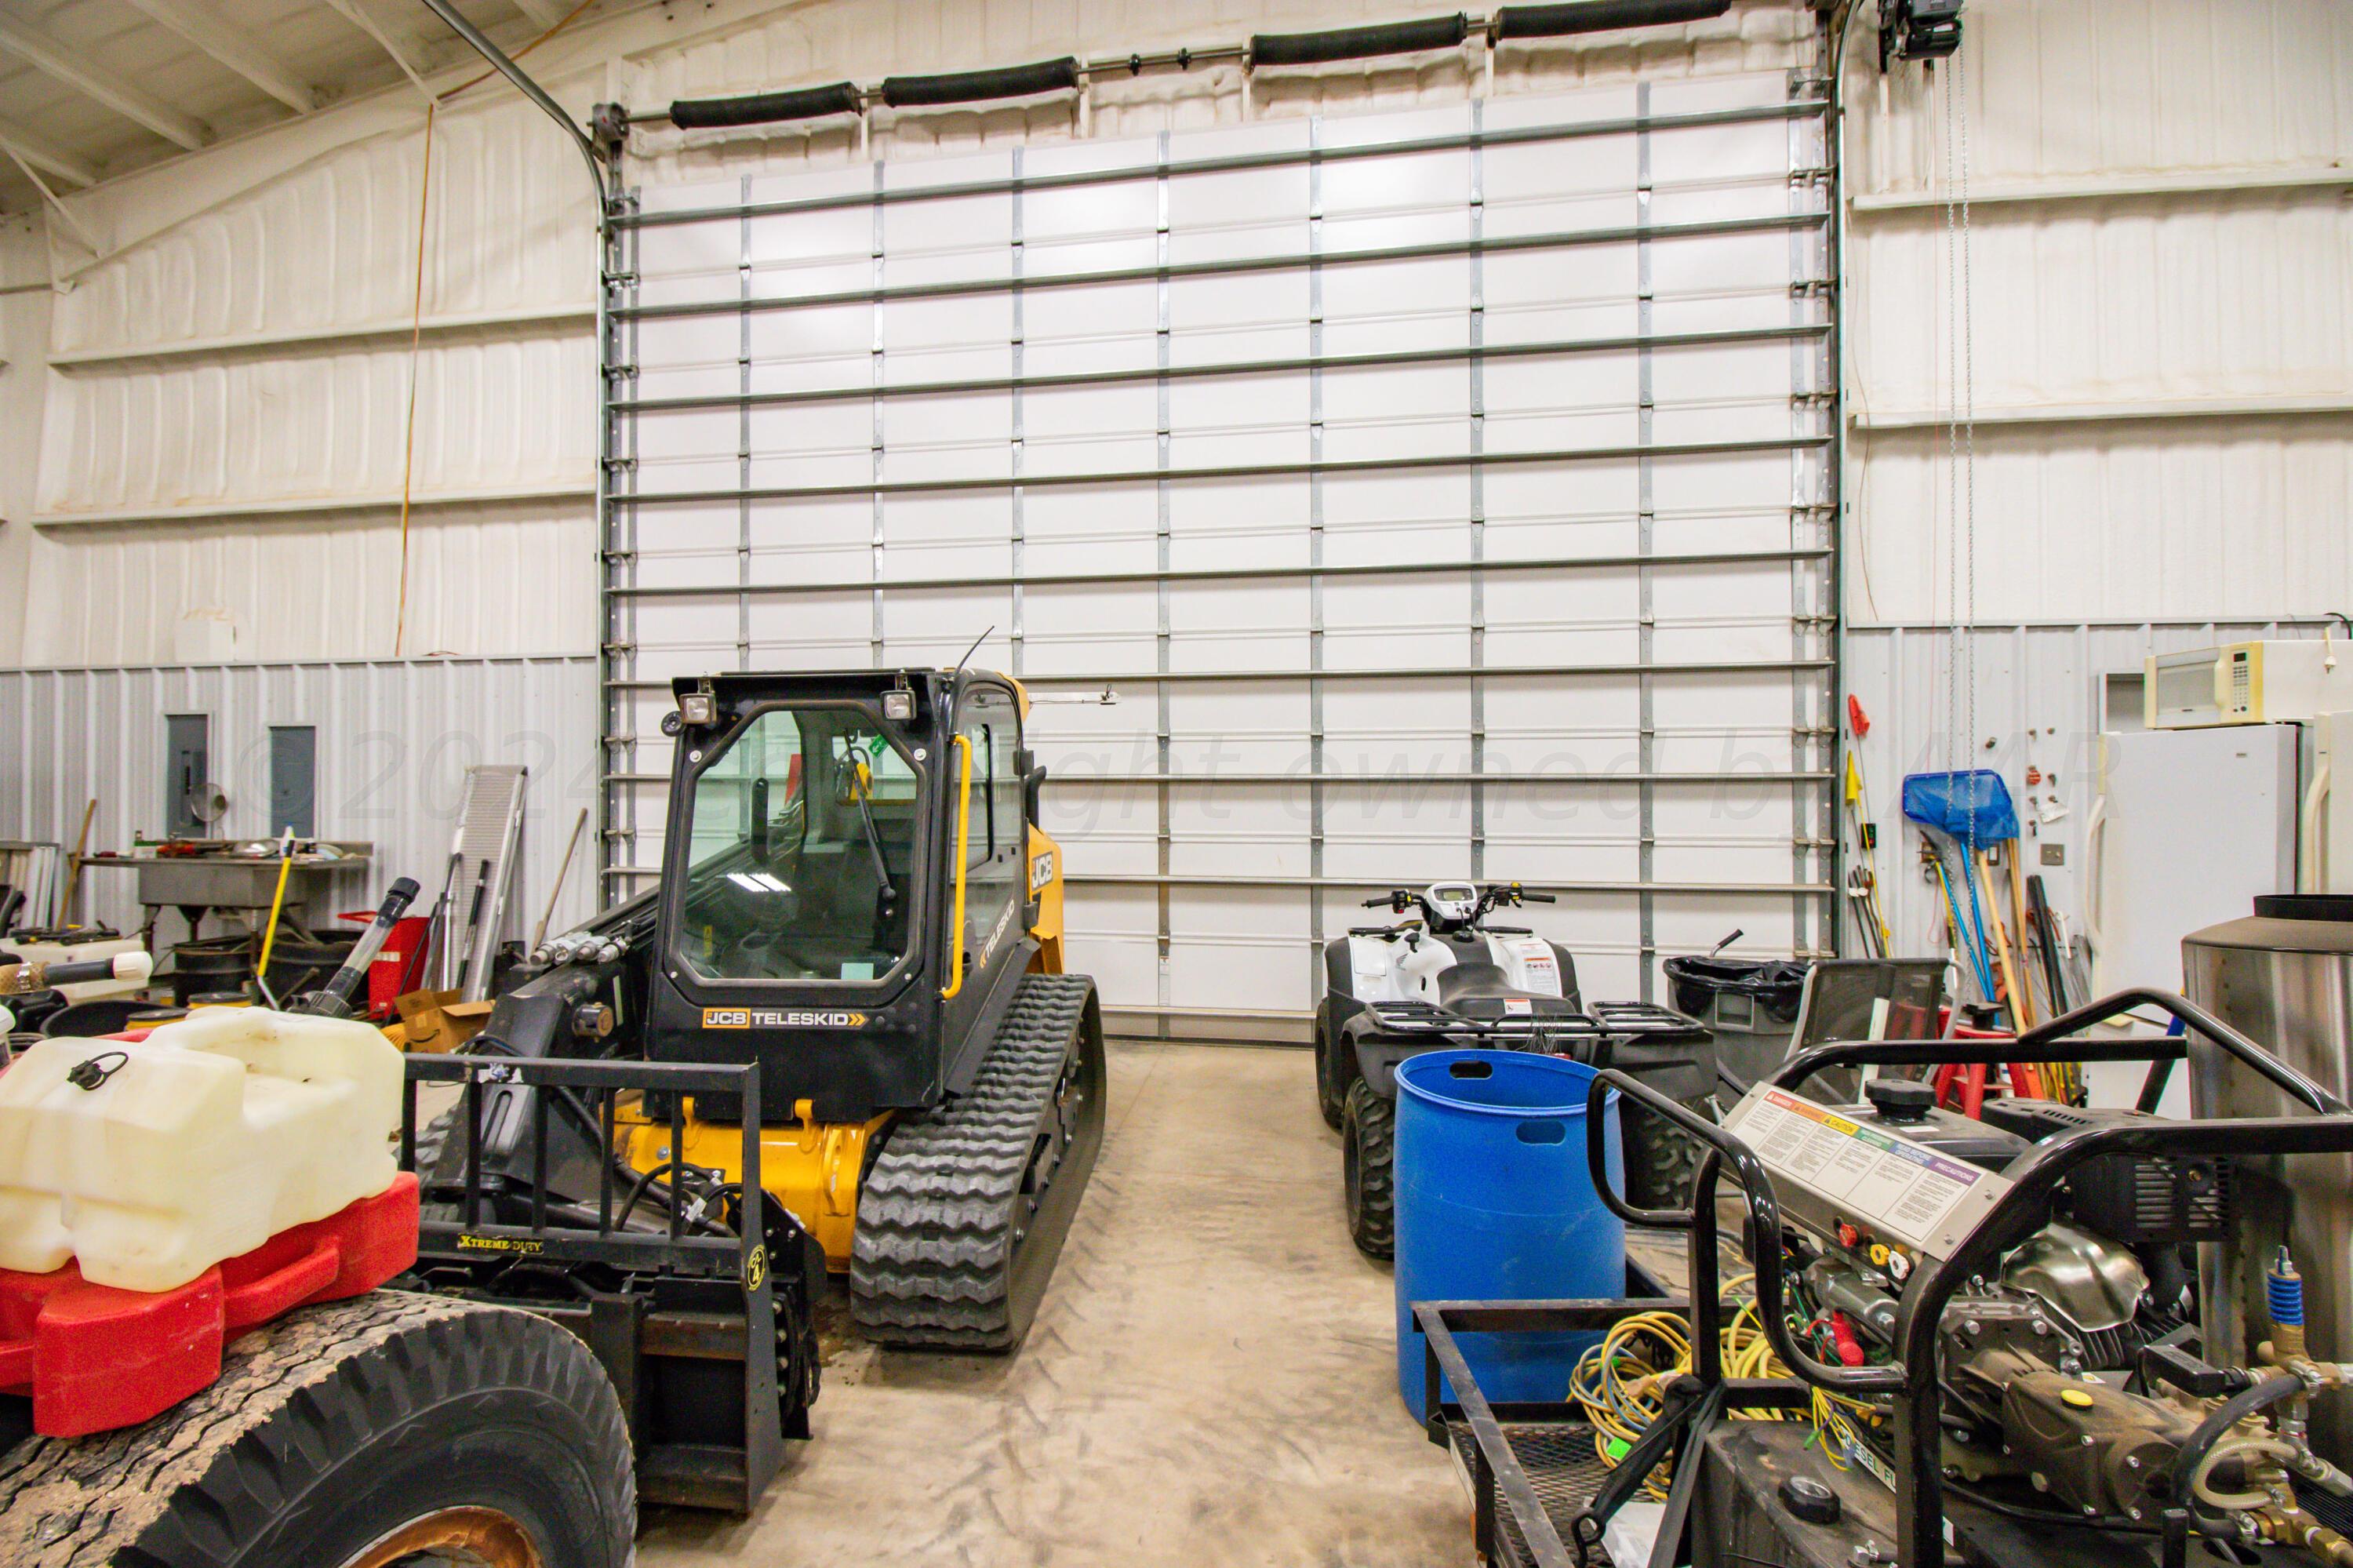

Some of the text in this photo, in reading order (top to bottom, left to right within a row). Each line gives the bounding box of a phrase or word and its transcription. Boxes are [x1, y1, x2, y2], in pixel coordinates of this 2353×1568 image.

[1032, 853, 1053, 889] JCB
[985, 899, 1014, 958] TELESKID
[707, 1012, 849, 1026] JCB TELESKID
[1935, 1162, 1975, 1182] PRECAUTIONS
[460, 1235, 542, 1251] XTREME DUTY
[1845, 1432, 1880, 1474] DESEL
